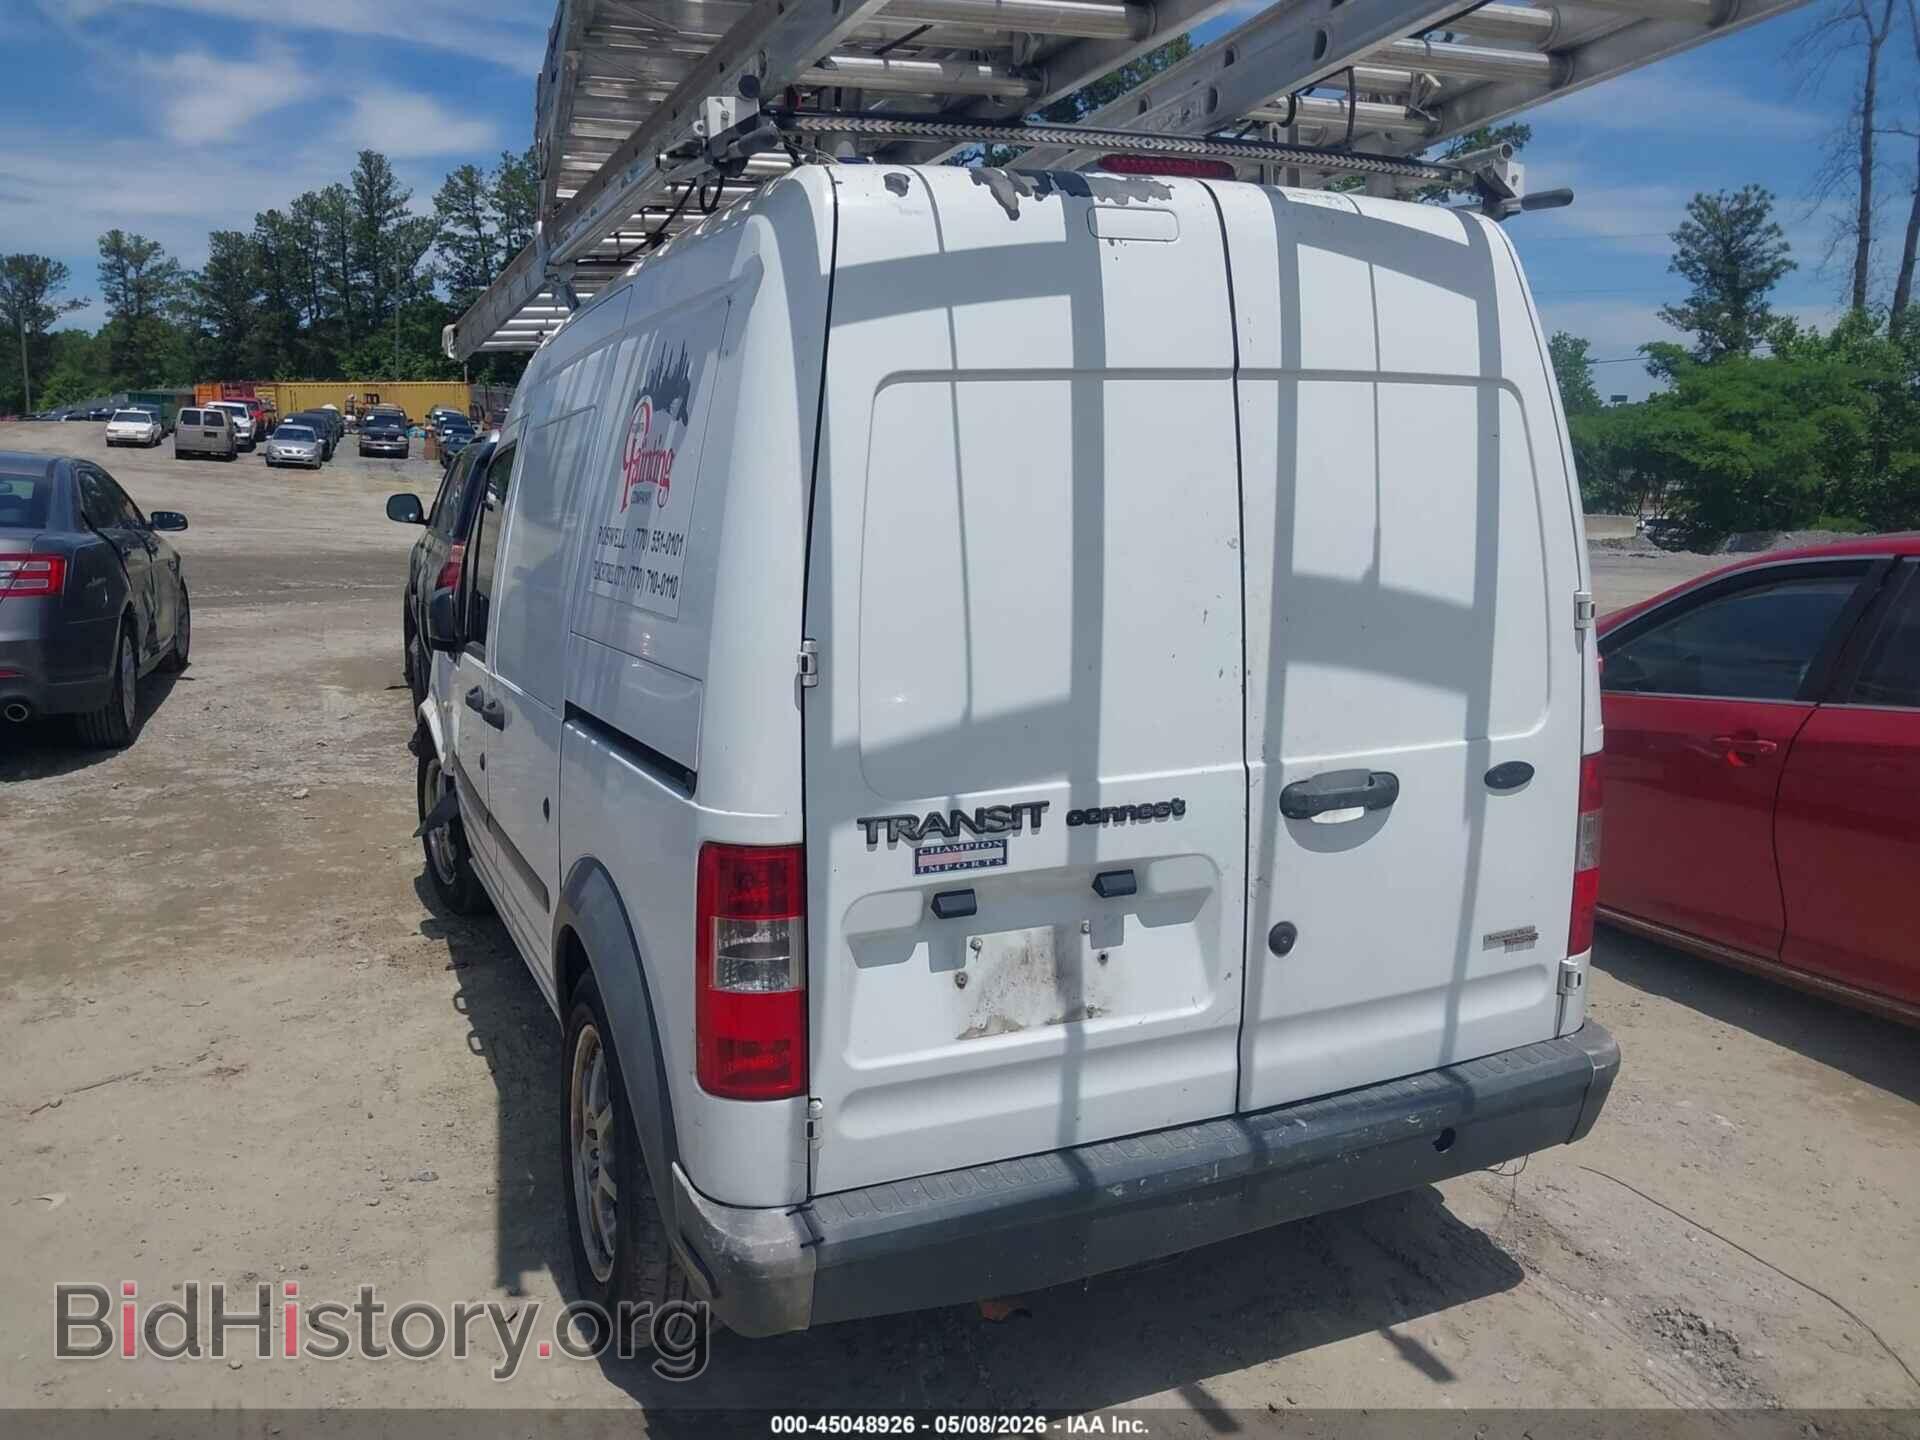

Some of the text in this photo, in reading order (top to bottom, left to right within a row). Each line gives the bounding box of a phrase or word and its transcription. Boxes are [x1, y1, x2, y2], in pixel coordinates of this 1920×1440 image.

[857, 797, 1187, 846] TRANSIT connect
[919, 840, 1004, 855] CHAMPION
[919, 858, 1004, 873] IMPORTS
